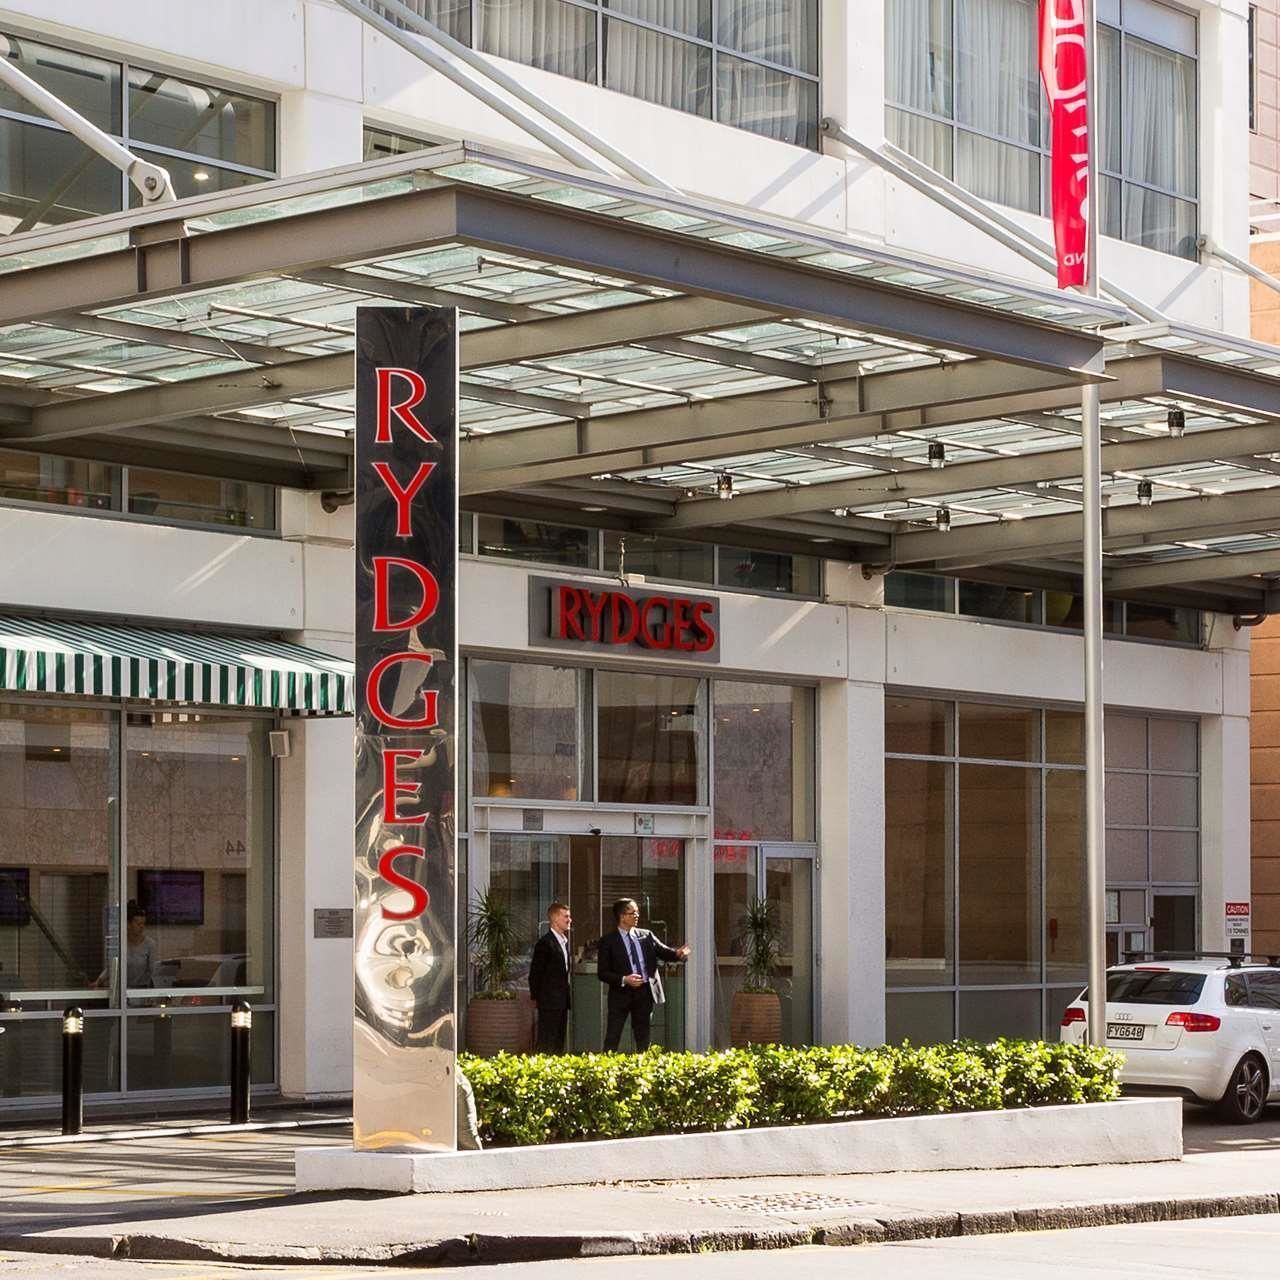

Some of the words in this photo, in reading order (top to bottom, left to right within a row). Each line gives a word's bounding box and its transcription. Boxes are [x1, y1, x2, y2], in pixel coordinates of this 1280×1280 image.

[366, 366, 441, 922] RYDGES
[556, 585, 716, 654] RYDGES
[1226, 904, 1249, 914] CAUTION
